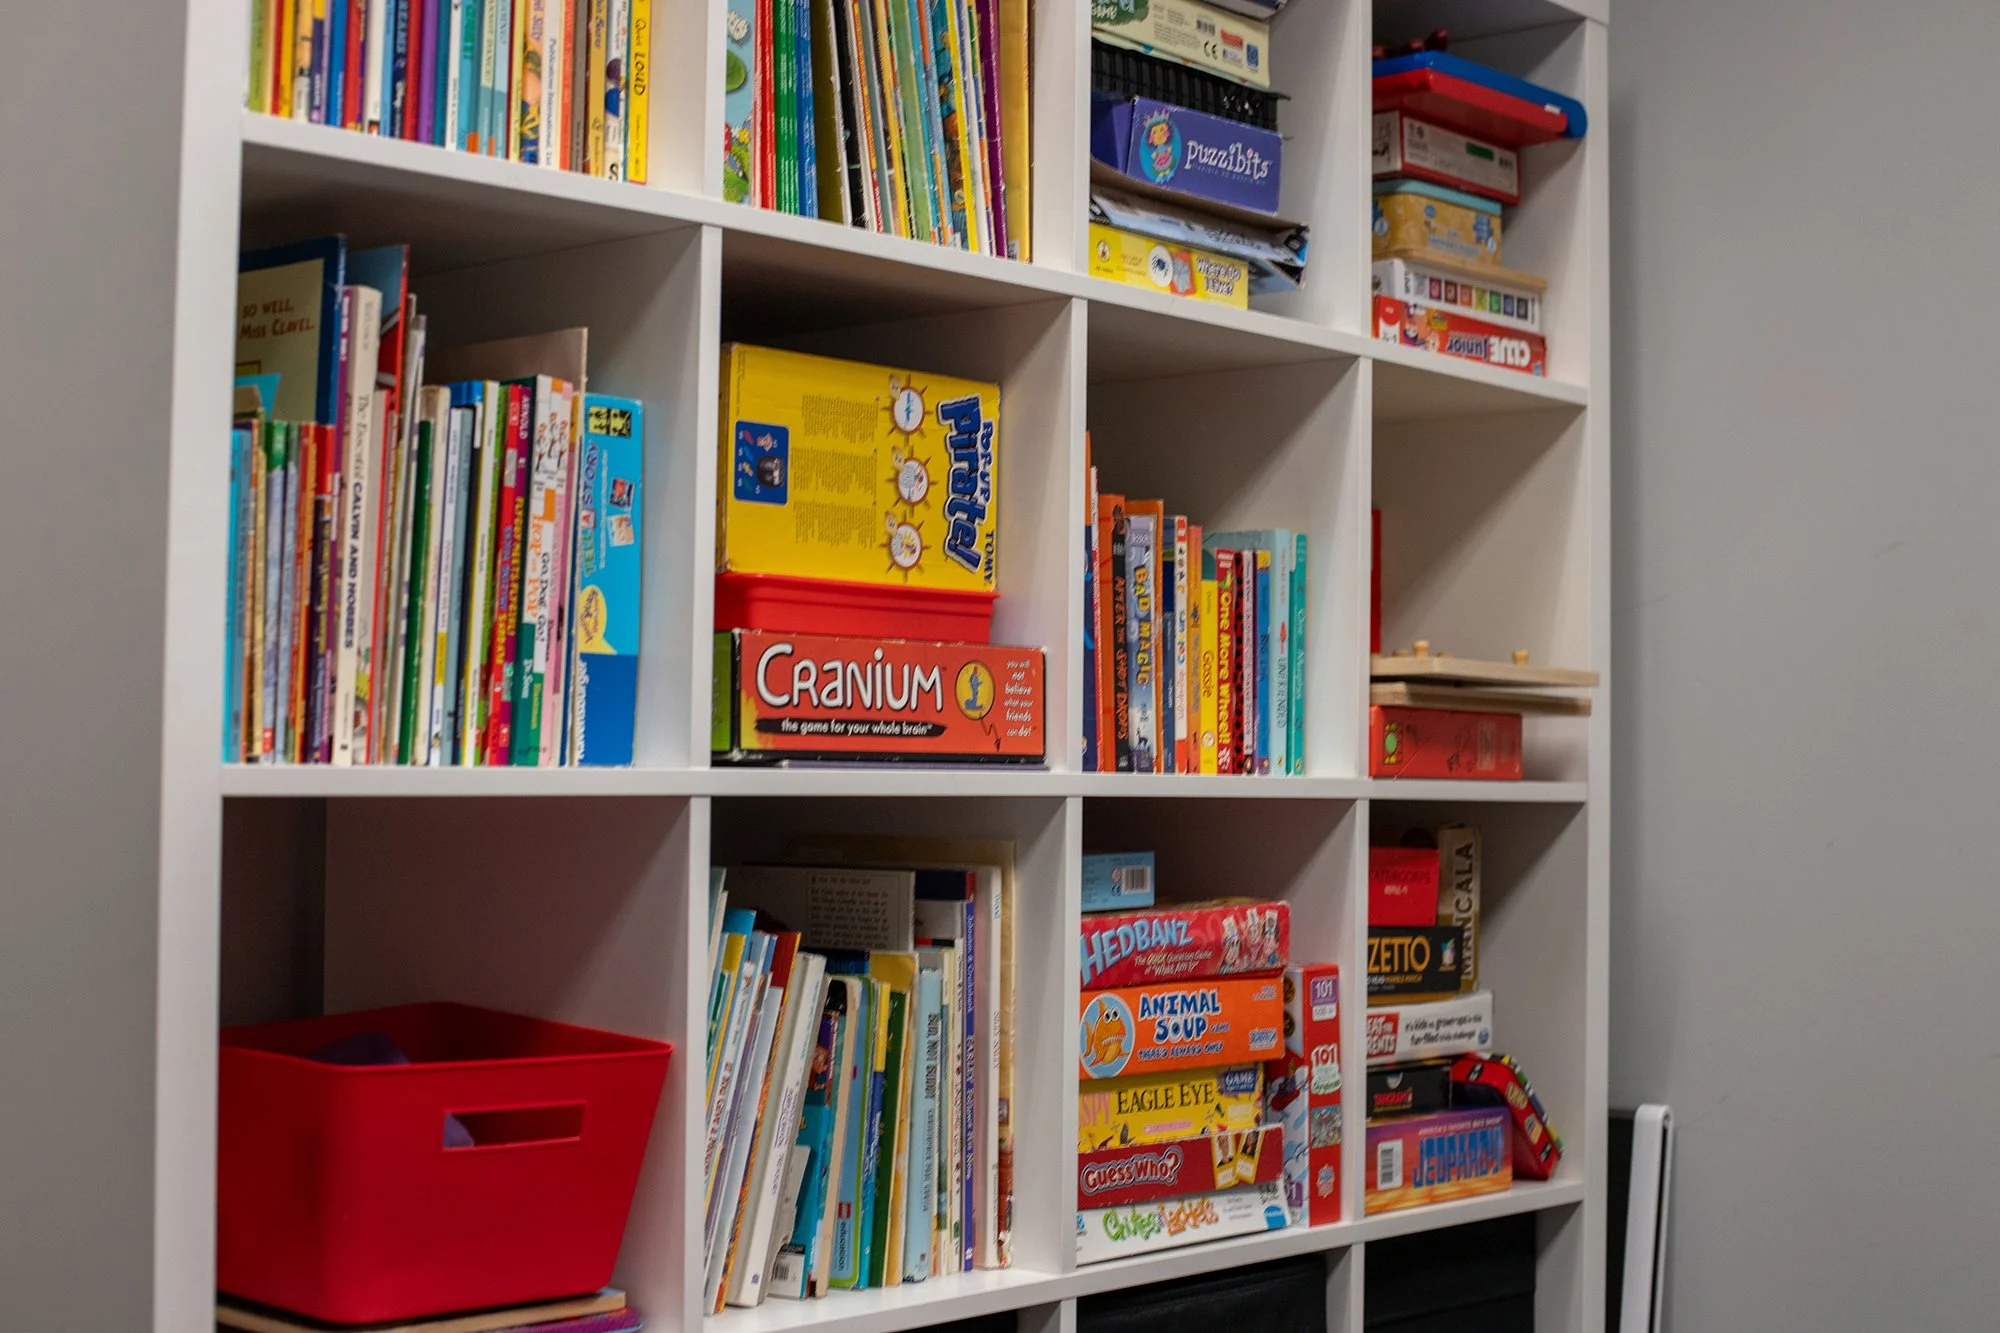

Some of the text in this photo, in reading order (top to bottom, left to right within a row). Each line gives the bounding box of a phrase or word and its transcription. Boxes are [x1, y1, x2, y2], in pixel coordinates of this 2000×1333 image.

[633, 53, 648, 96] LOUD
[1184, 140, 1269, 180] puzzibits
[242, 297, 294, 319] SO WELL
[1446, 335, 1531, 367] CLUE Junior
[519, 395, 531, 440] ARNOLD
[582, 440, 600, 506] STORY
[979, 419, 995, 504] POP-UP
[937, 396, 988, 572] Pirate!
[351, 482, 364, 541] CALVIN
[530, 514, 543, 557] HOP
[984, 529, 995, 584] TOMY
[348, 545, 359, 580] AND
[344, 582, 357, 650] HOBBES
[526, 577, 540, 619] POP
[1114, 576, 1126, 624] AFTER
[1219, 590, 1232, 630] One
[1133, 566, 1152, 686] BAD MAGIC
[1012, 671, 1025, 681] not
[1202, 651, 1215, 698] Gossie
[1219, 632, 1231, 680] More
[521, 672, 532, 700] Seuss
[1005, 683, 1032, 696] believe
[781, 717, 928, 737] the game for your whole brain
[1006, 708, 1032, 722] friends
[1115, 692, 1128, 741] DROPS
[1080, 917, 1195, 988] HEDBANZ
[1140, 990, 1222, 1021] ANIMAL
[1314, 980, 1333, 999] 101
[926, 1039, 939, 1062] NOT
[1154, 1016, 1208, 1044] SOUP
[1313, 1047, 1336, 1067] 101
[1116, 1088, 1176, 1116] EAGLE
[1178, 1083, 1215, 1107] EYE
[1413, 1126, 1505, 1189] JEOPARDY!
[837, 1220, 851, 1271] education
